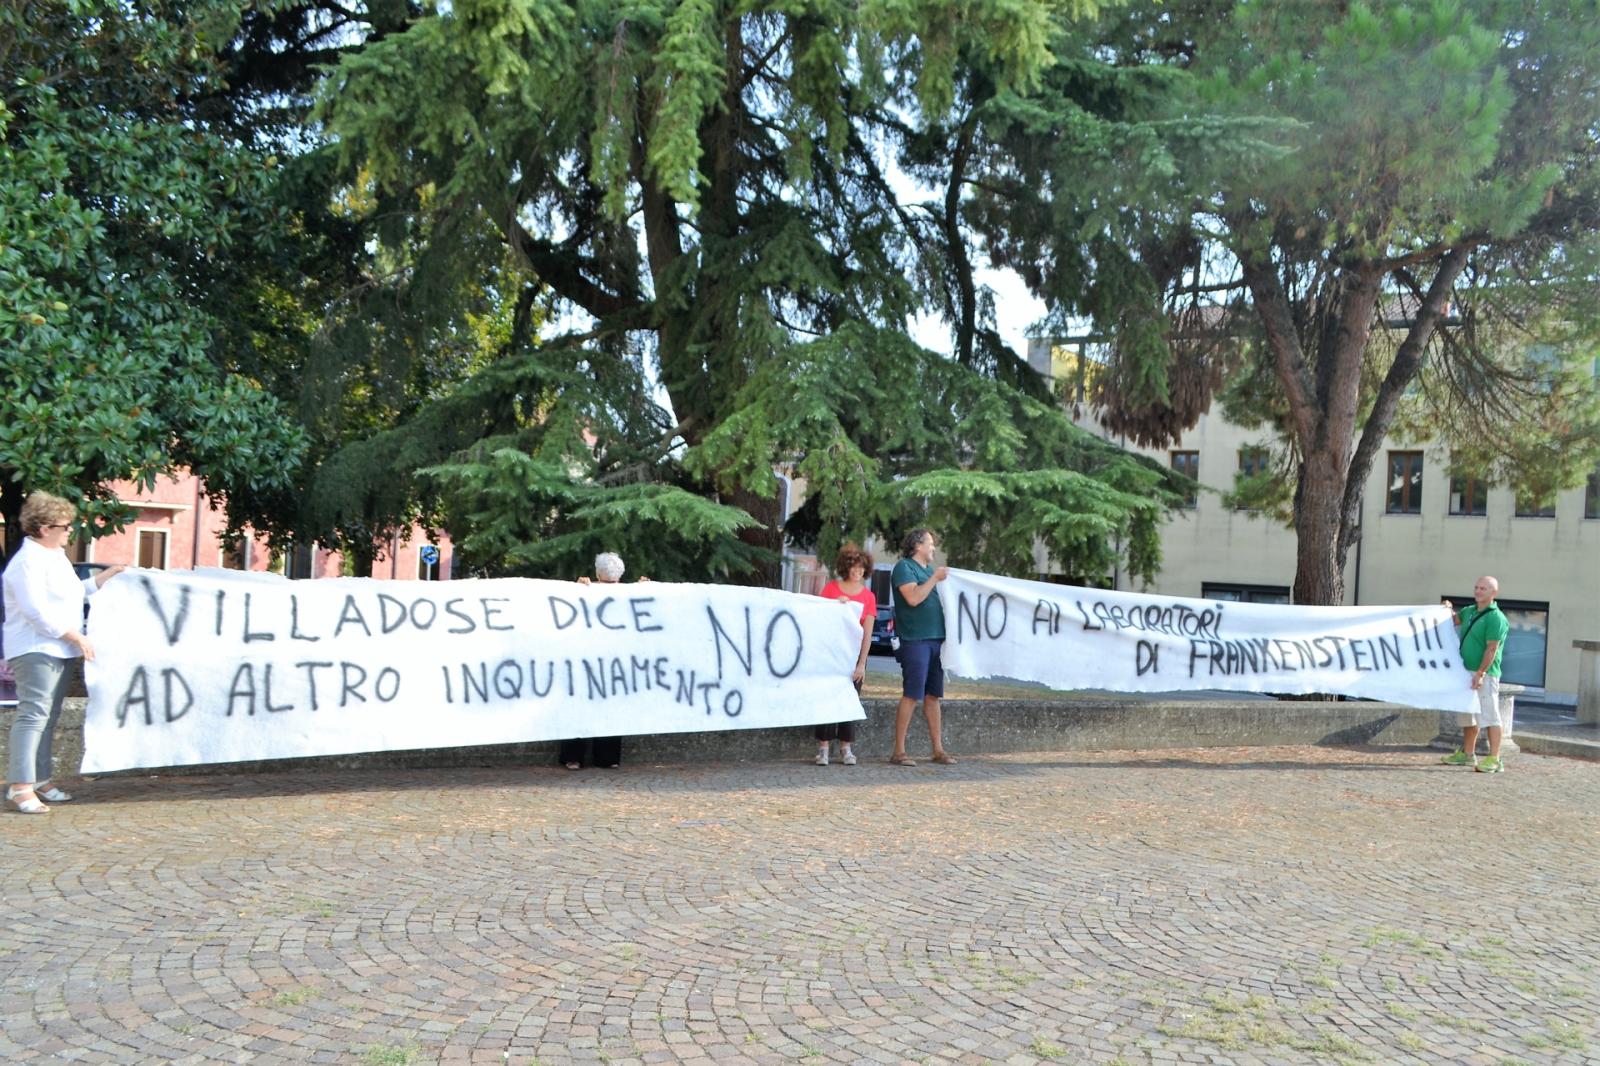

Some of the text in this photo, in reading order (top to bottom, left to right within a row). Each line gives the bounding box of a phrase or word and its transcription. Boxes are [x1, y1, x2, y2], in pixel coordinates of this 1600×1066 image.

[140, 576, 801, 680] VILLADOSE DICE NO
[958, 591, 1008, 644] NO
[1032, 599, 1060, 636] AI
[1136, 640, 1158, 676] DI
[116, 655, 743, 728] AD ALTRO INQUINAMENTO
